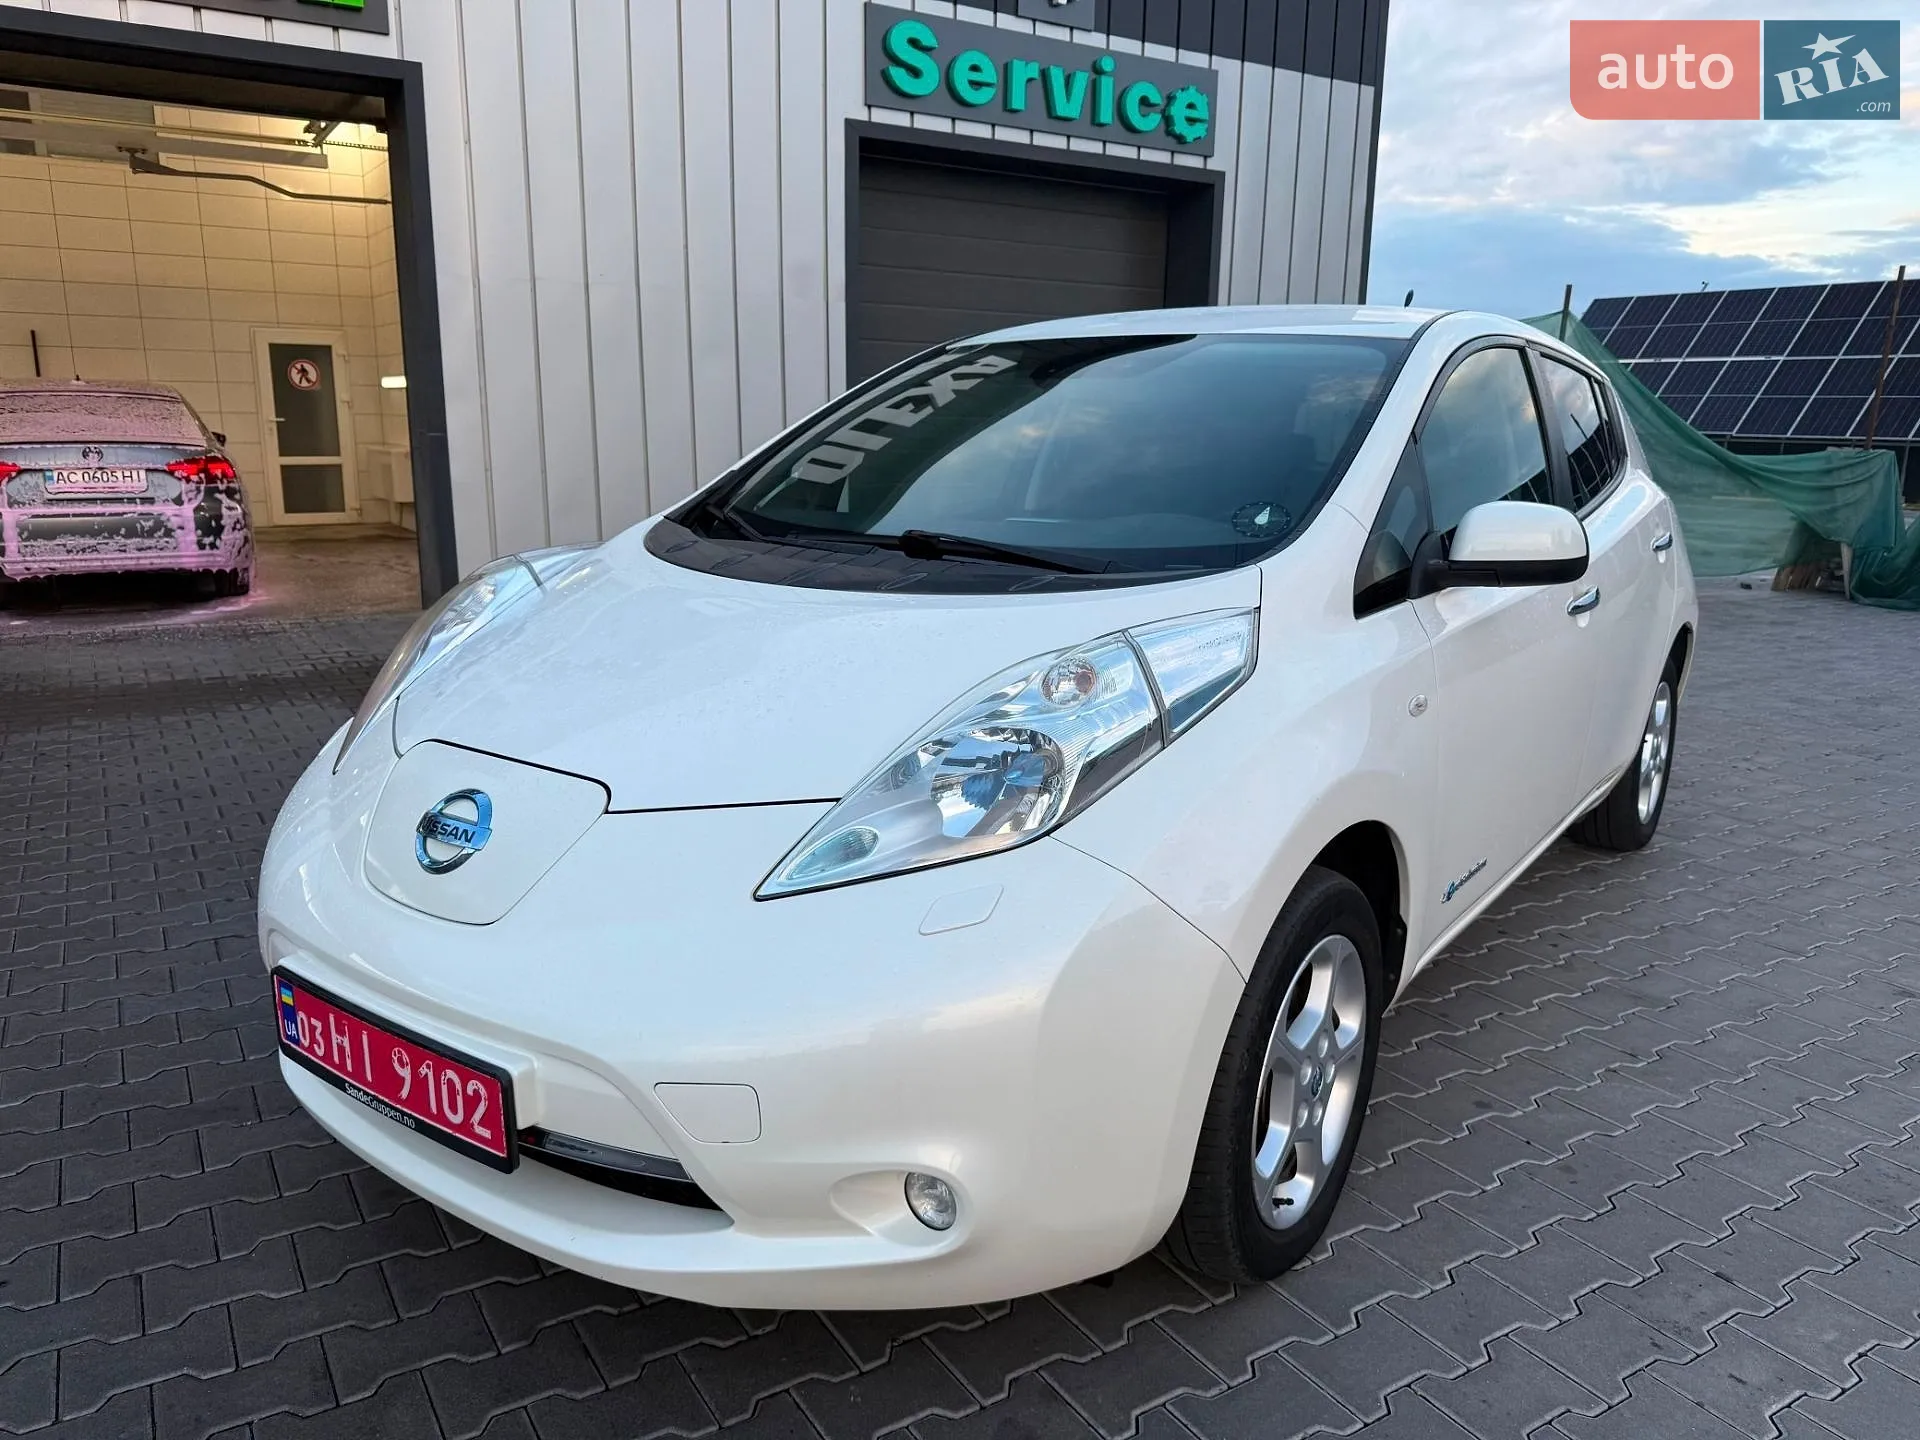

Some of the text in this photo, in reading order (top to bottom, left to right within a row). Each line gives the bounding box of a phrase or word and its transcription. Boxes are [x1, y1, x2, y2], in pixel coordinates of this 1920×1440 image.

[880, 19, 1209, 144] Service
[56, 470, 141, 484] AC 0605 HI
[421, 813, 476, 844] NISSAN
[285, 1021, 298, 1040] UA
[297, 1011, 492, 1140] 03 HI 9102
[345, 1082, 416, 1129] SandeGruppen.no
